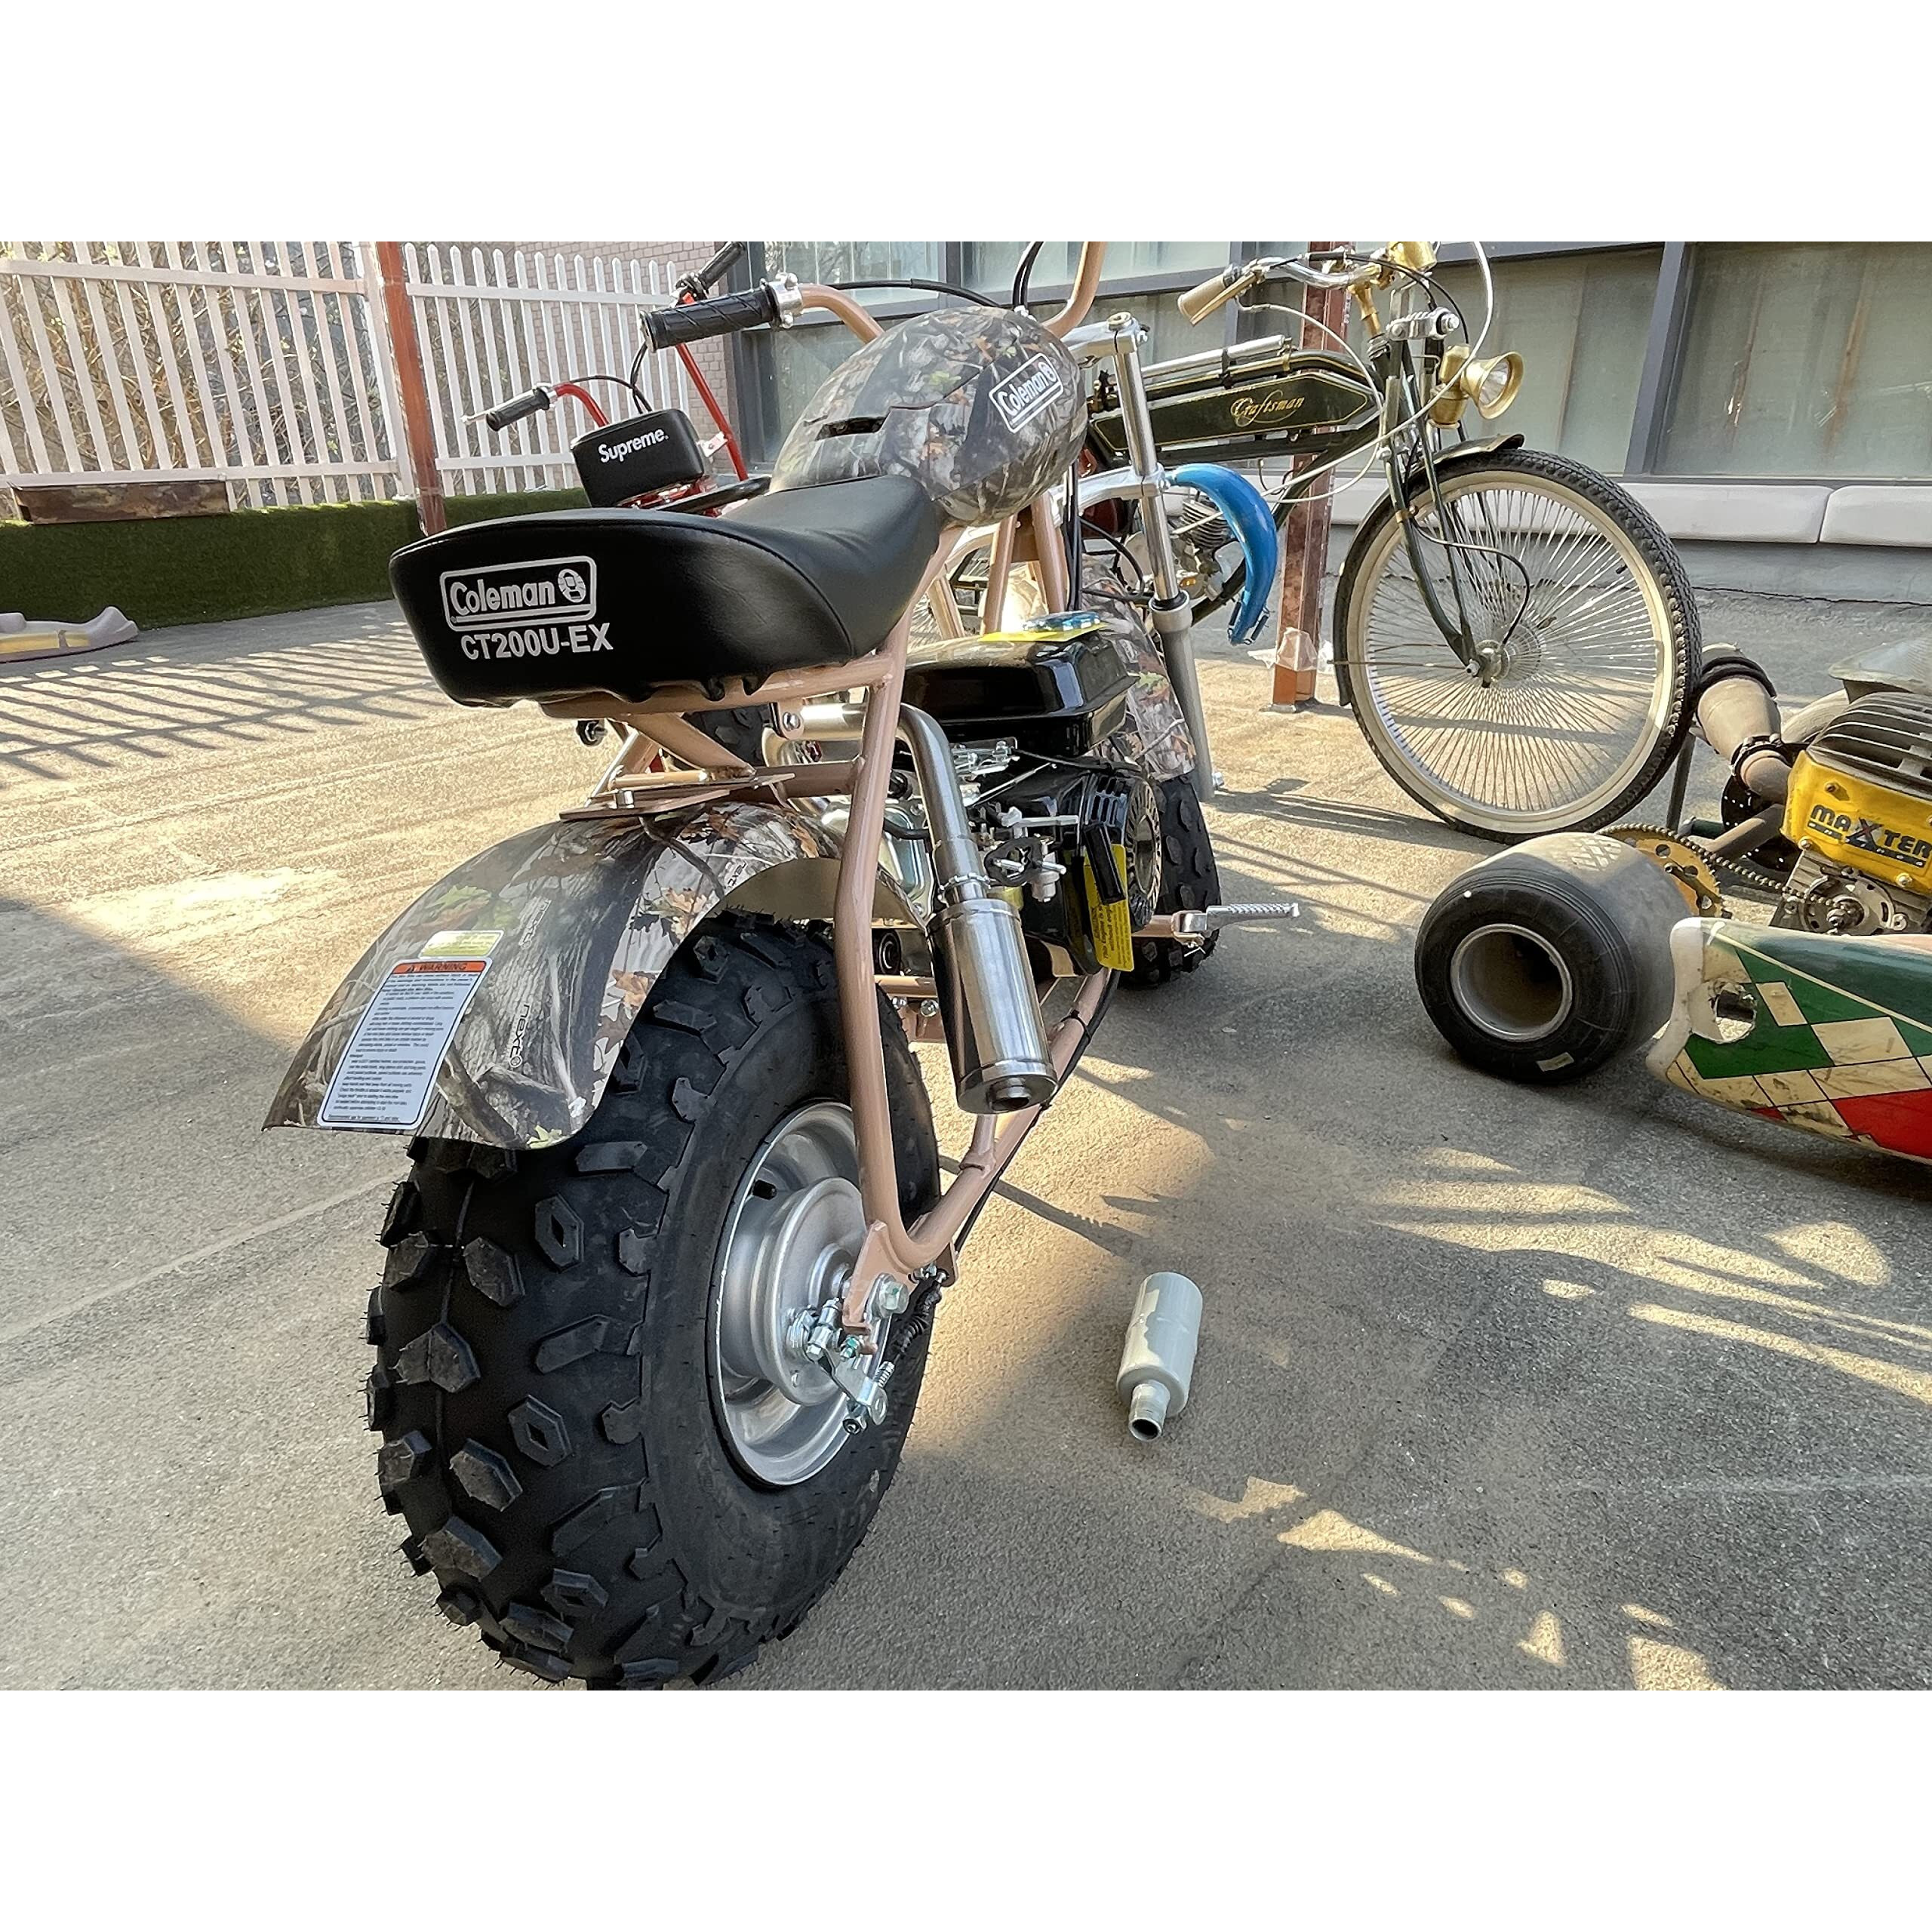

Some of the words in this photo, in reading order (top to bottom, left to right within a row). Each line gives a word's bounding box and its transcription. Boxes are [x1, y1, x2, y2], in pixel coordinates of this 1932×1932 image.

[998, 372, 1049, 416] Coleman
[1230, 389, 1305, 427] Craftsman
[450, 579, 555, 616] Coleman
[461, 623, 614, 660] CT200U-EX
[419, 963, 467, 971] WARNING
